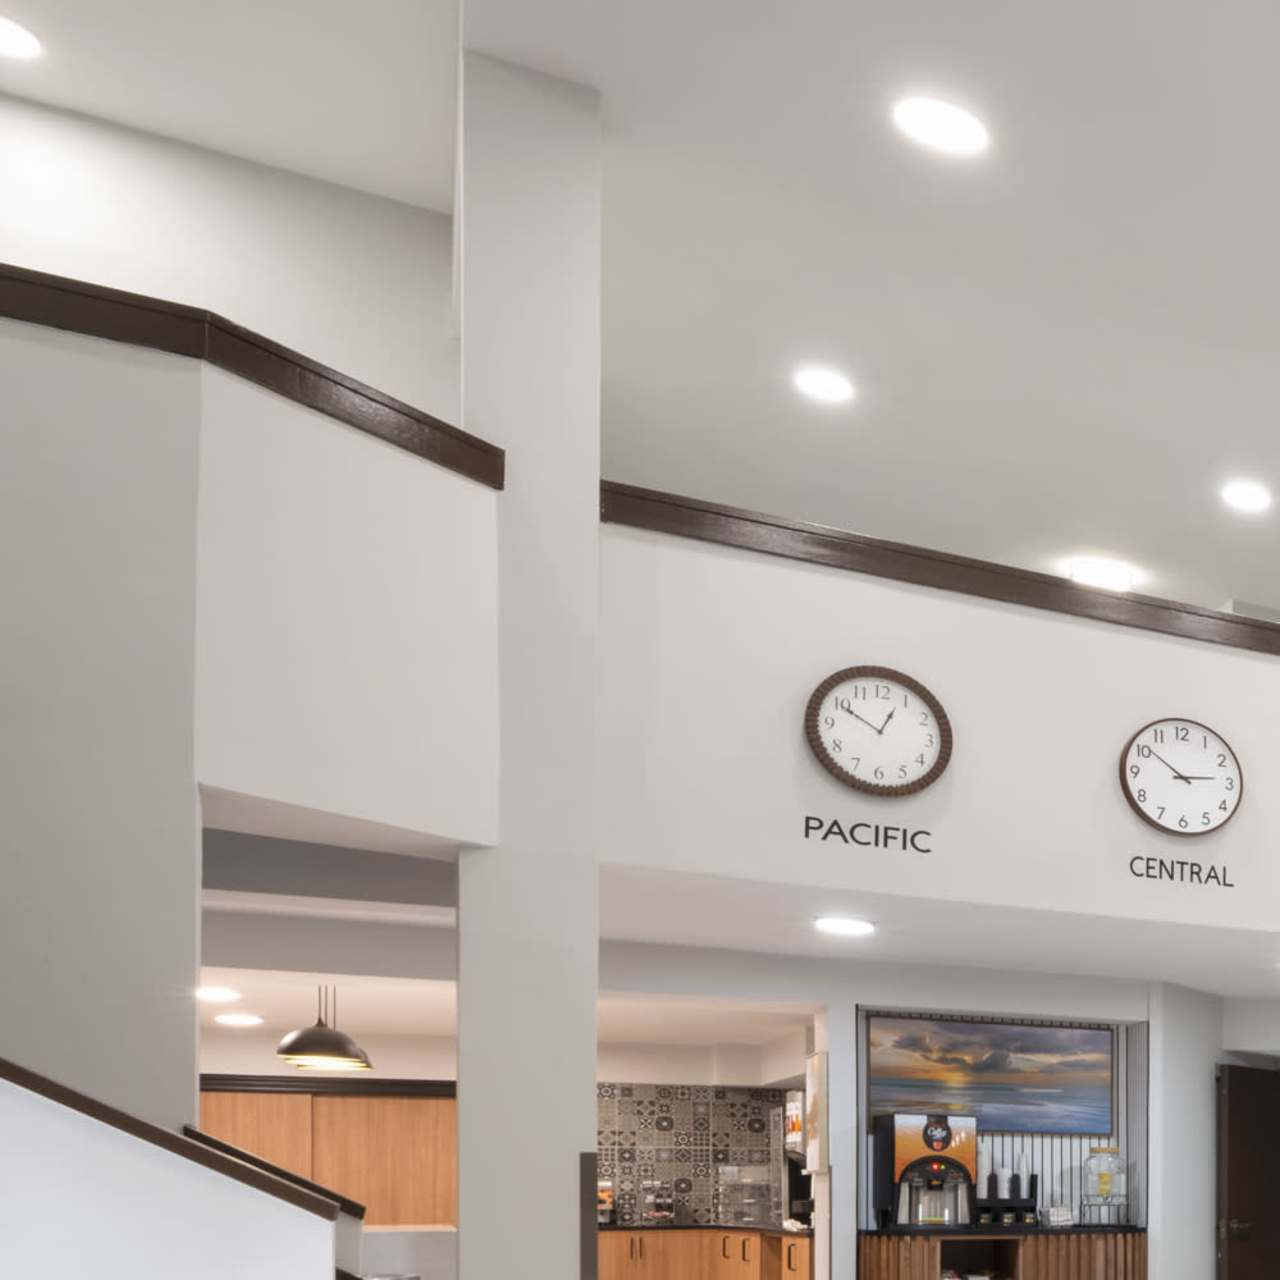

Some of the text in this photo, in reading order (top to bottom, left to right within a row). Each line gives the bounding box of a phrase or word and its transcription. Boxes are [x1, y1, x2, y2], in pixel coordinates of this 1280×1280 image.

[854, 685, 866, 701] 11
[874, 684, 891, 700] 12
[835, 696, 851, 711] 10
[825, 717, 835, 729] 9
[919, 712, 928, 726] 2
[925, 734, 933, 748] 3
[1153, 729, 1164, 744] 11
[1175, 726, 1190, 742] 12
[832, 738, 842, 752] 8
[1137, 744, 1151, 758] 10
[851, 757, 861, 772] 7
[915, 753, 925, 767] 4
[1217, 754, 1226, 767] 2
[874, 766, 885, 780] 6
[898, 765, 907, 778] 5
[1130, 765, 1140, 778] 9
[1225, 777, 1234, 791] 3
[1137, 788, 1147, 803] 8
[1218, 799, 1227, 811] 4
[1156, 806, 1166, 820] 7
[1201, 812, 1211, 826] 5
[1178, 815, 1189, 829] 6
[804, 816, 932, 853] PACIFIC
[1129, 855, 1235, 887] CENTRAL
